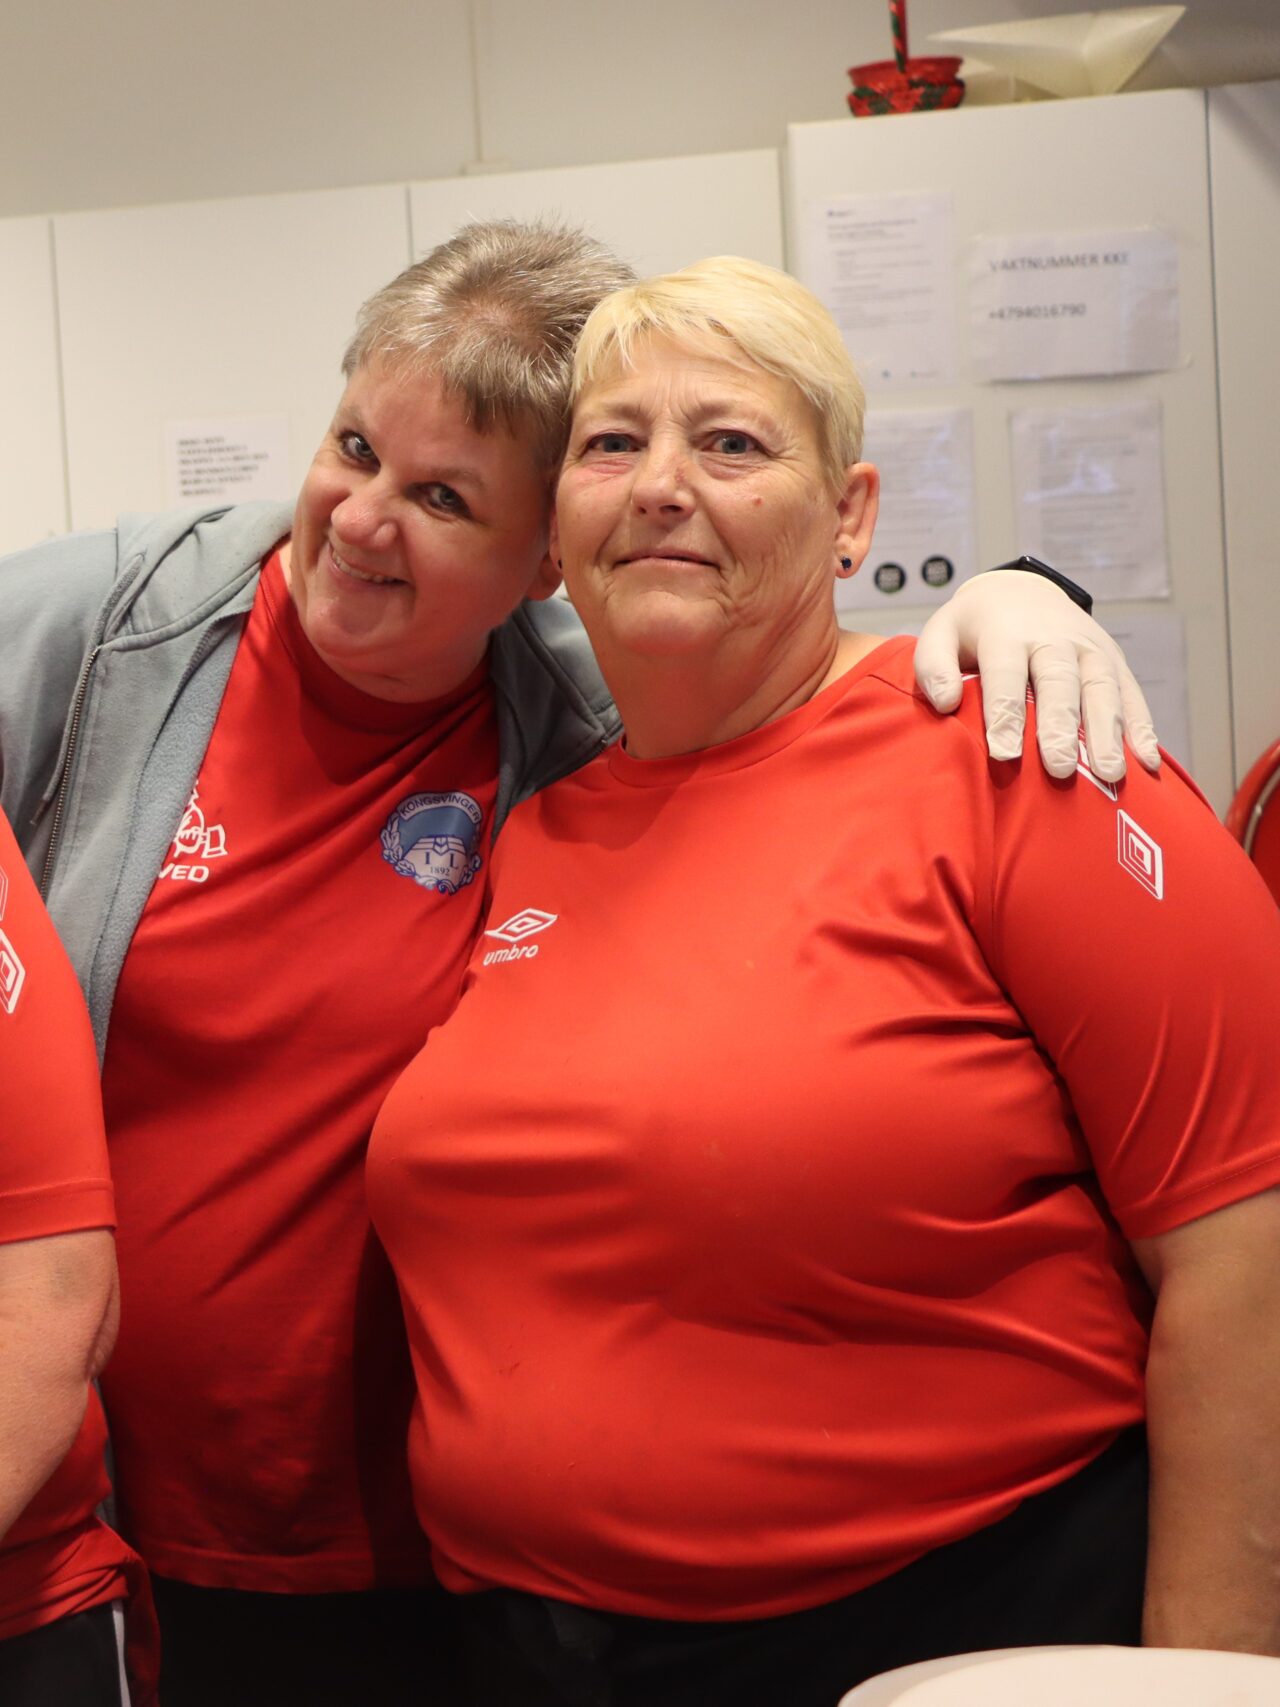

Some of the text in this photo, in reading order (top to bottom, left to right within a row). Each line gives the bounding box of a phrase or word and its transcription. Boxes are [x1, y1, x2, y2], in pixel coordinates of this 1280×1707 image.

[988, 253, 1098, 271] VAKTNUMMER
[400, 794, 480, 822] KONGSVINGER
[430, 866, 450, 876] 1892
[483, 944, 540, 966] umbro
